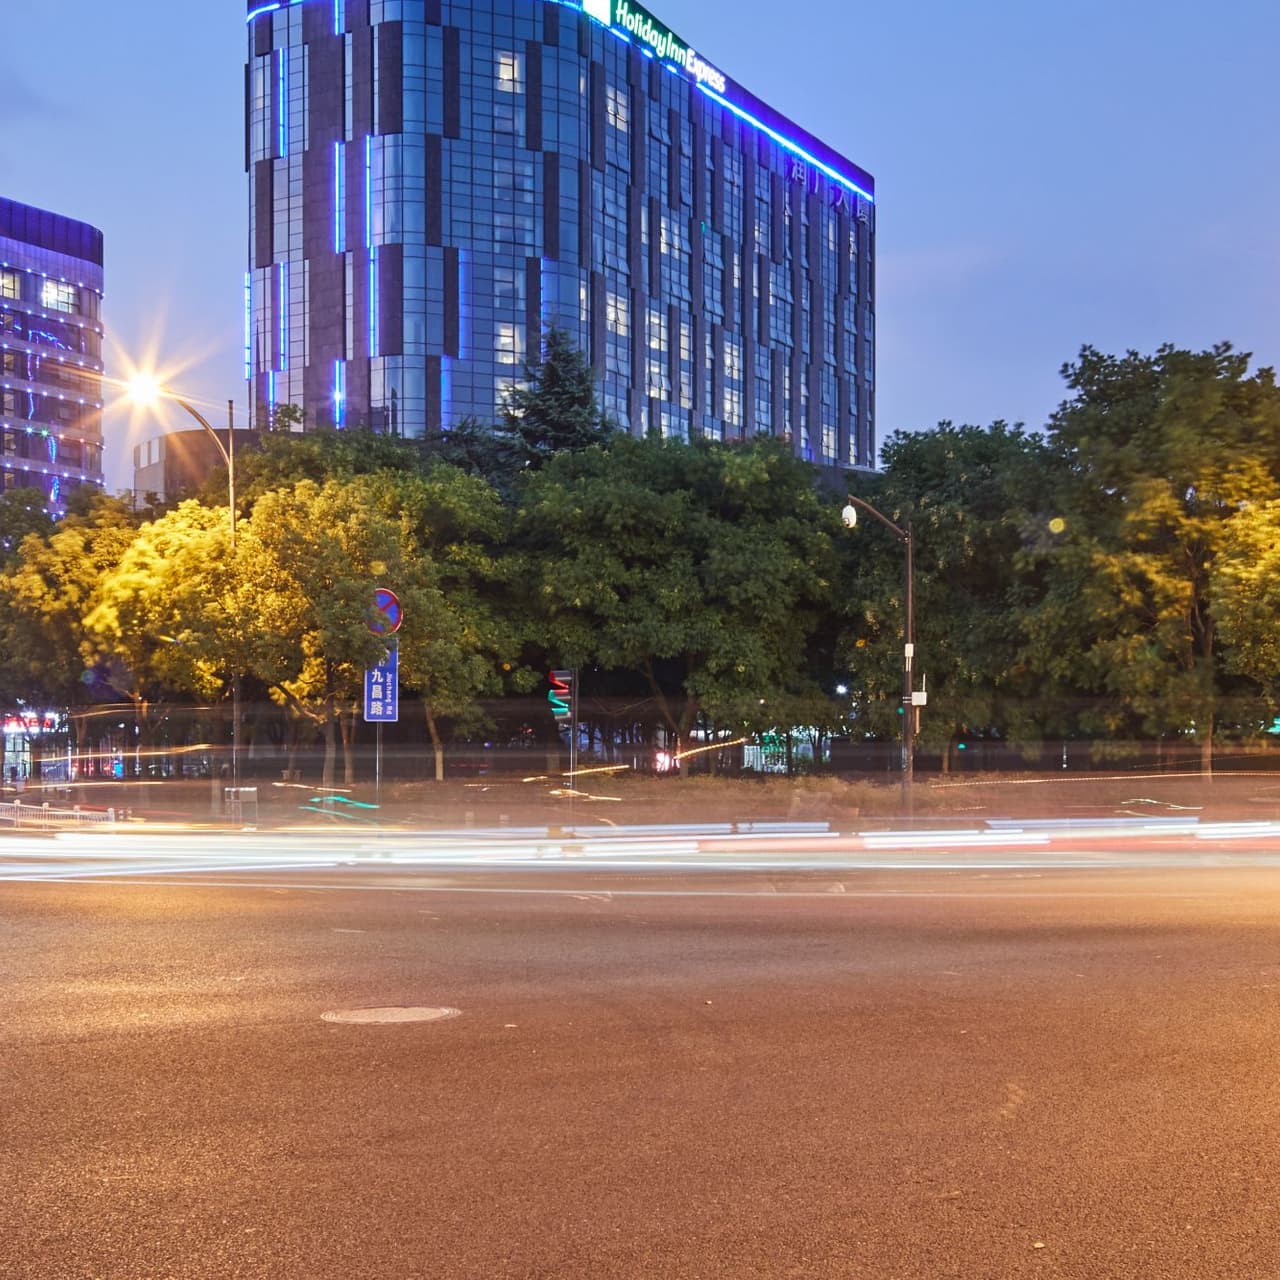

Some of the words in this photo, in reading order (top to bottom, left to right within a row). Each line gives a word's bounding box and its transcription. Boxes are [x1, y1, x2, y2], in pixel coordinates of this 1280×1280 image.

[666, 32, 687, 67] Inn
[686, 48, 726, 93] Express
[370, 668, 384, 716] 九昌路
